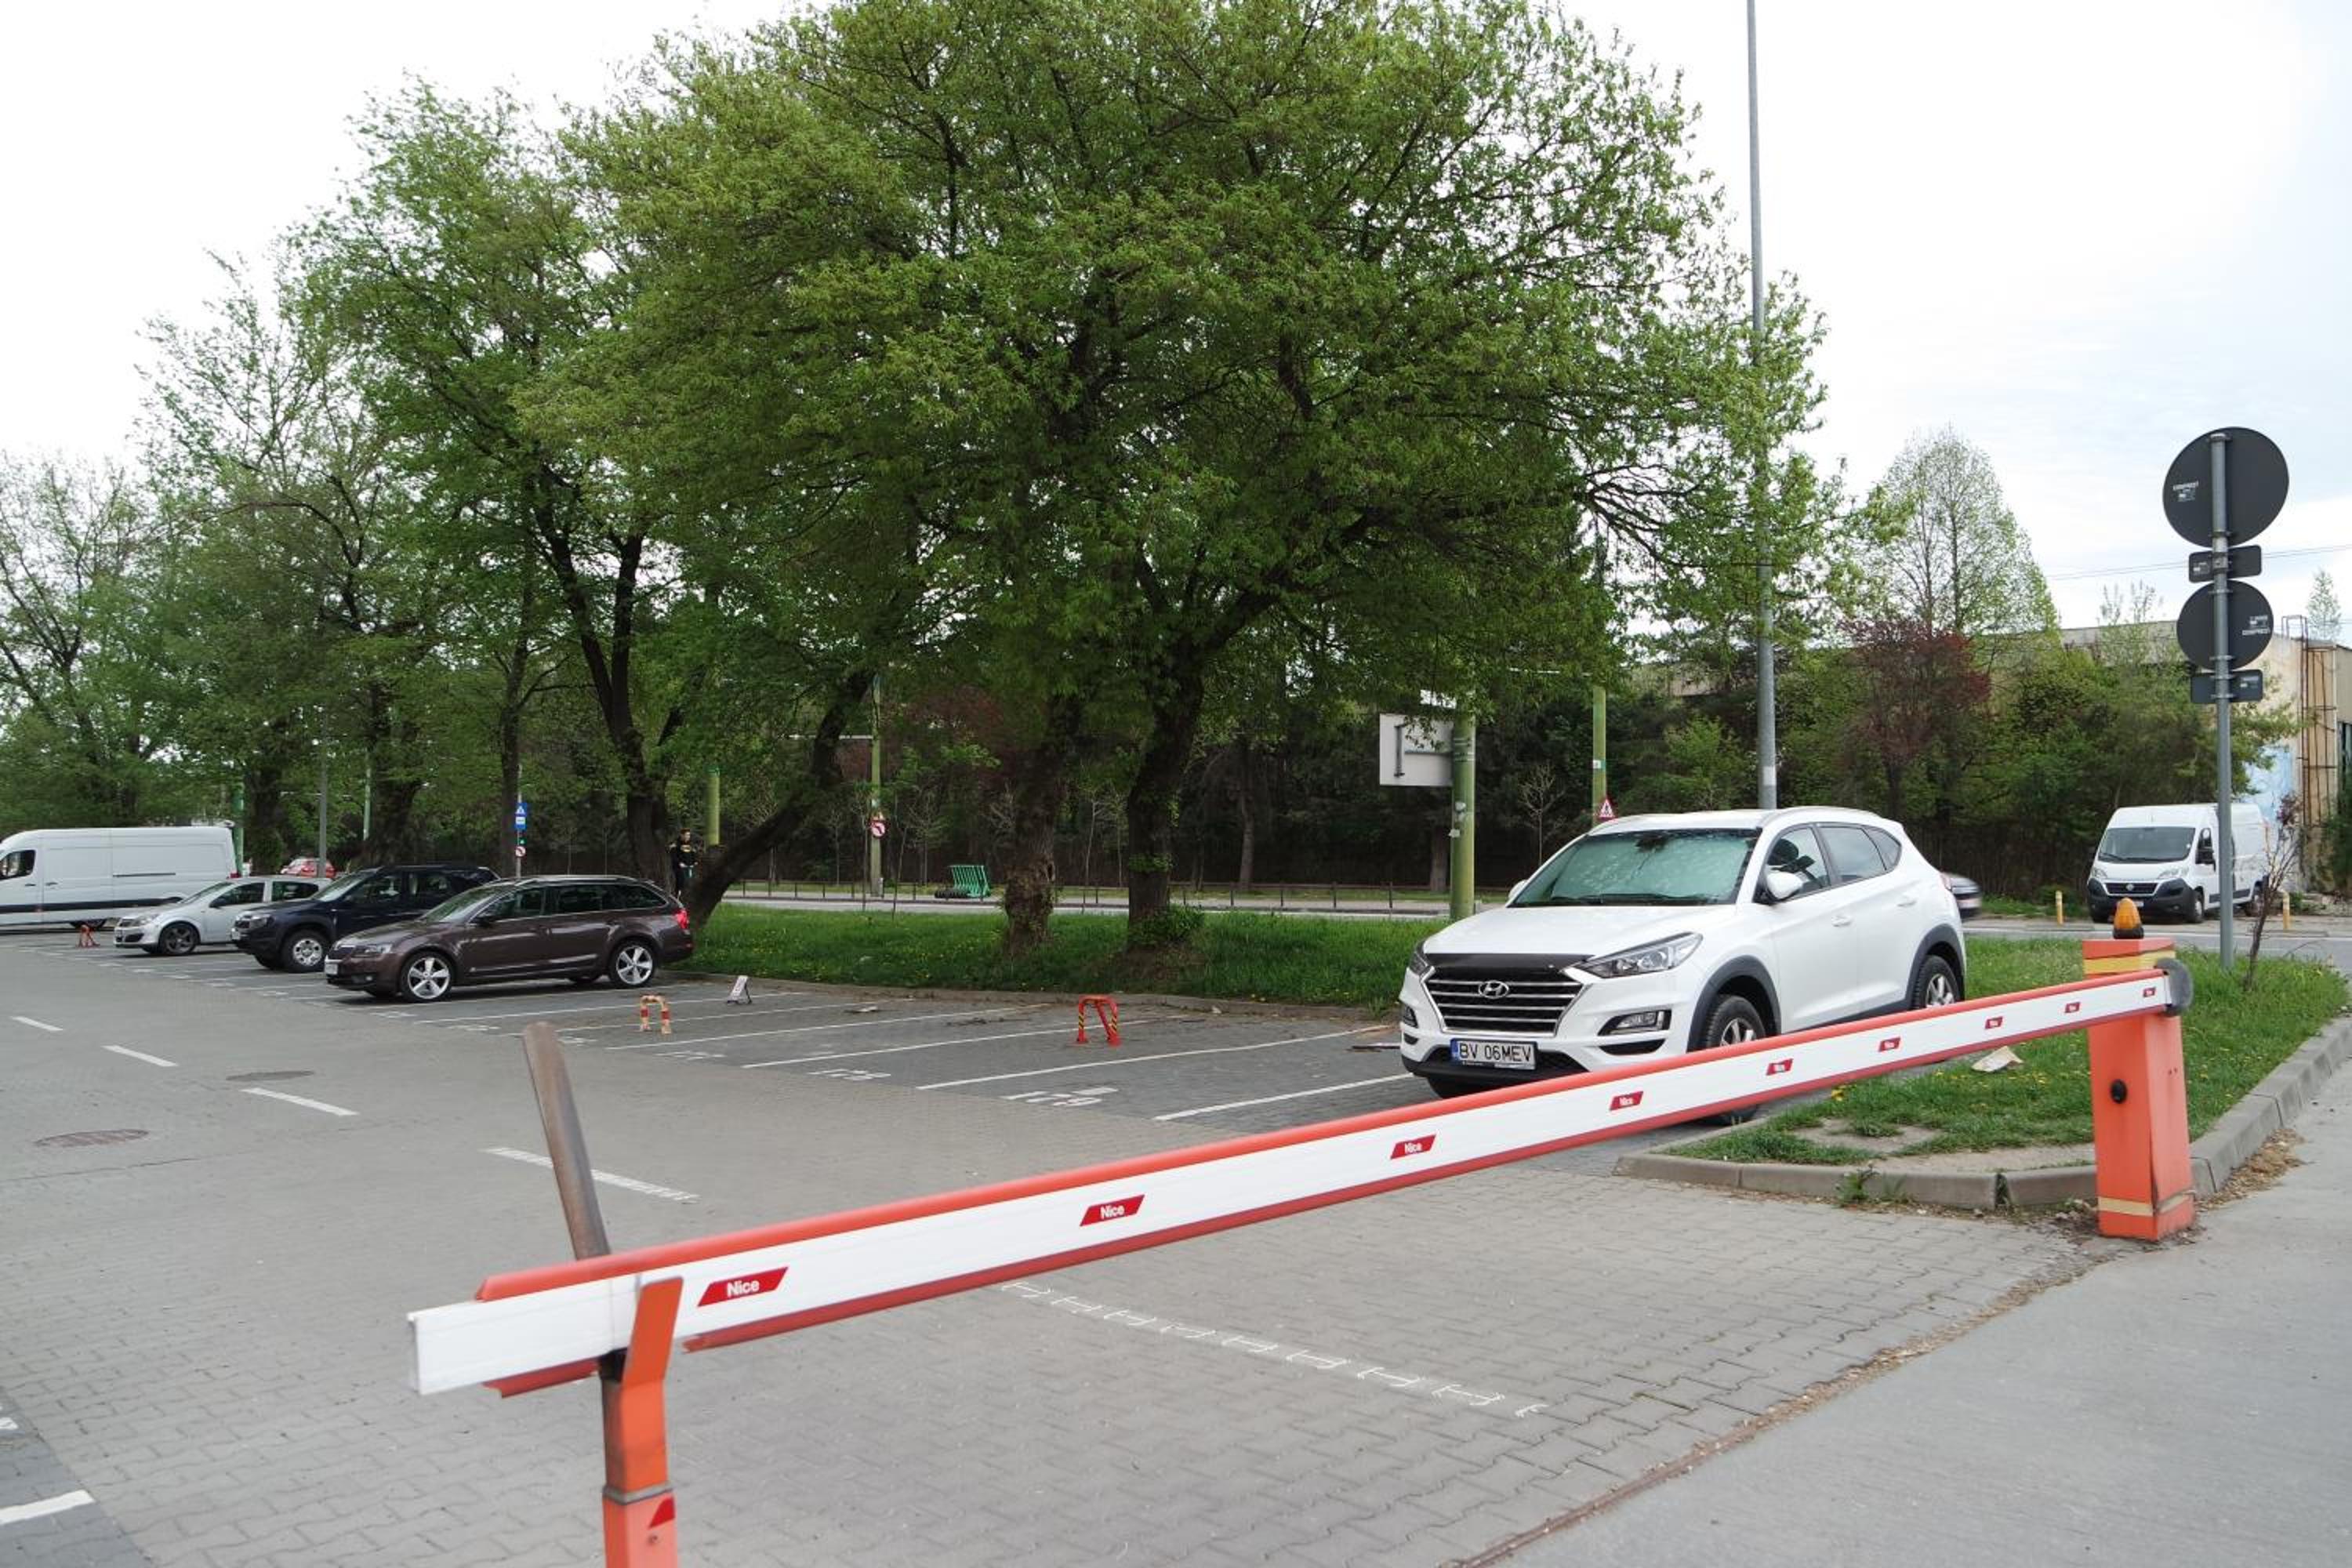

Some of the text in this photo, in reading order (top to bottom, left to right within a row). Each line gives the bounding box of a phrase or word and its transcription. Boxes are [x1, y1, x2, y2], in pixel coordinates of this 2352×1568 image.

[1459, 1042, 1478, 1059] BV
[1100, 1204, 1125, 1219] Nice
[726, 1279, 760, 1298] Nice
